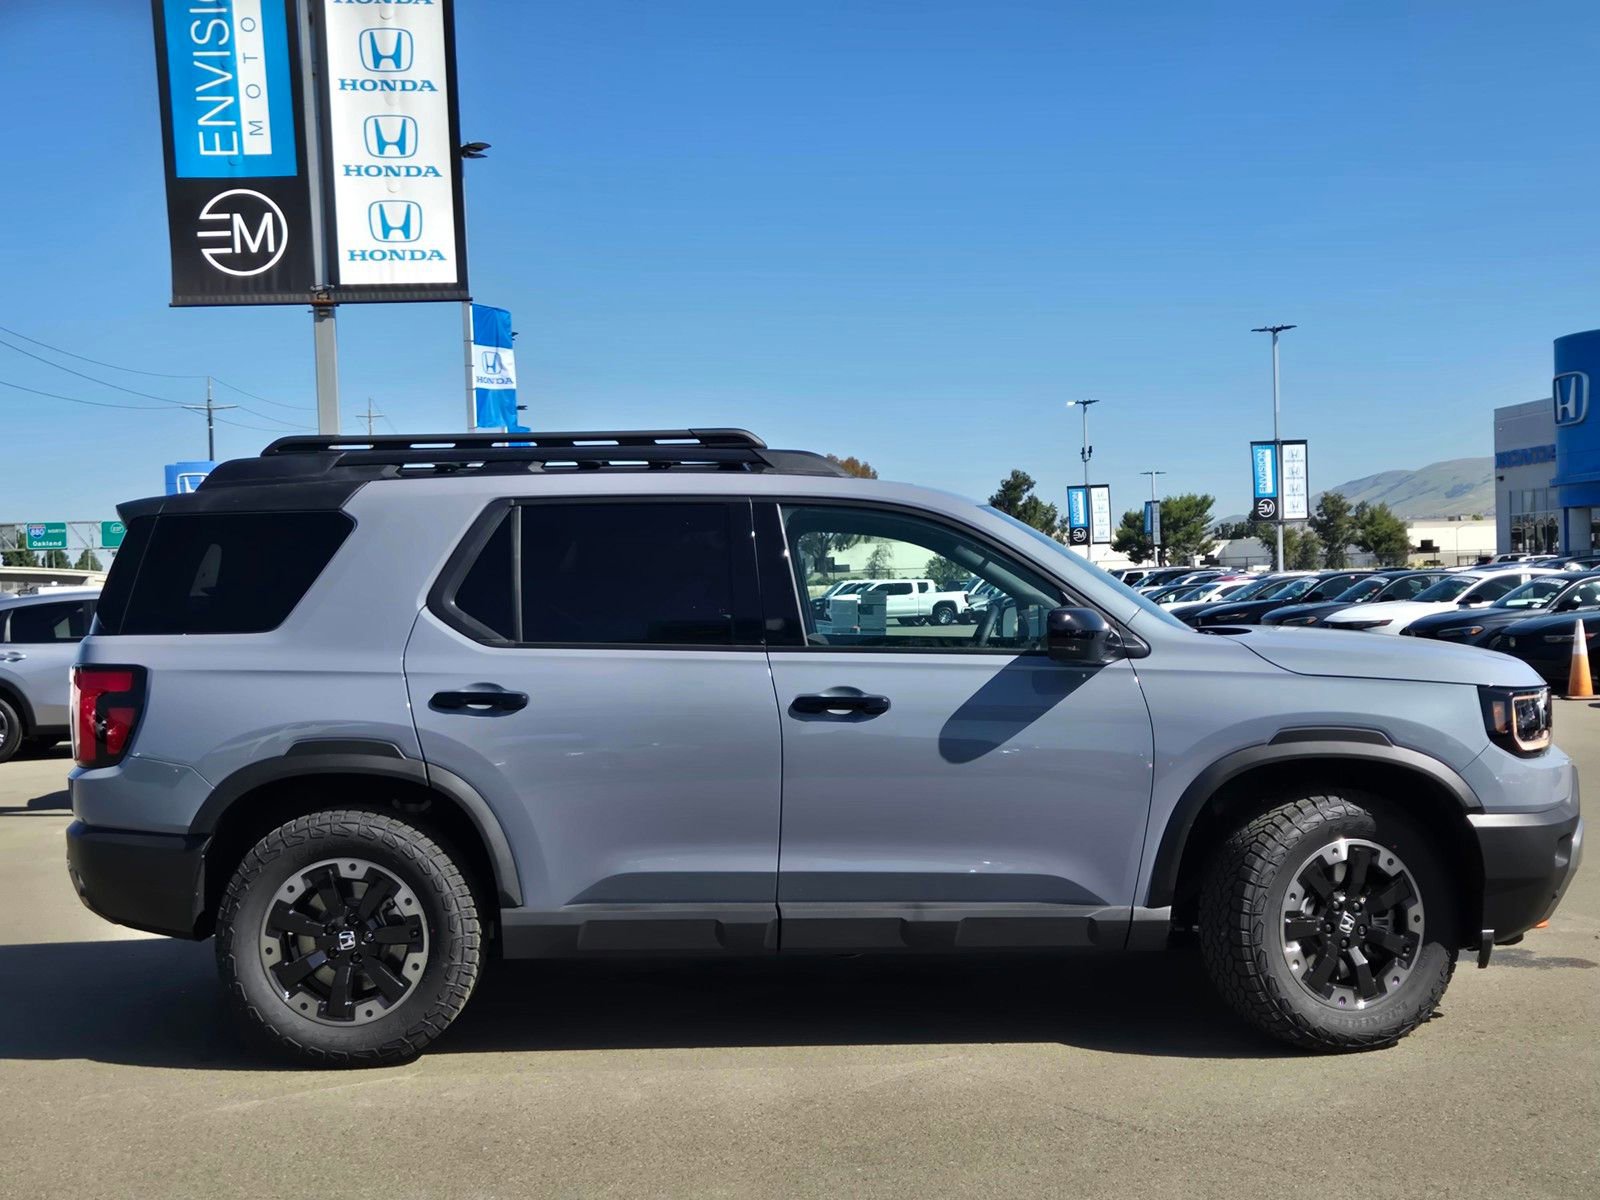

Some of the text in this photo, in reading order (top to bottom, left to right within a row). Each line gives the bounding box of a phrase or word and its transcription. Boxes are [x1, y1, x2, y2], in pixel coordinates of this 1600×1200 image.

[189, 0, 239, 155] ENVISI
[338, 79, 438, 92] HONDA
[343, 164, 443, 178] HONDA
[347, 249, 448, 261] HONDA
